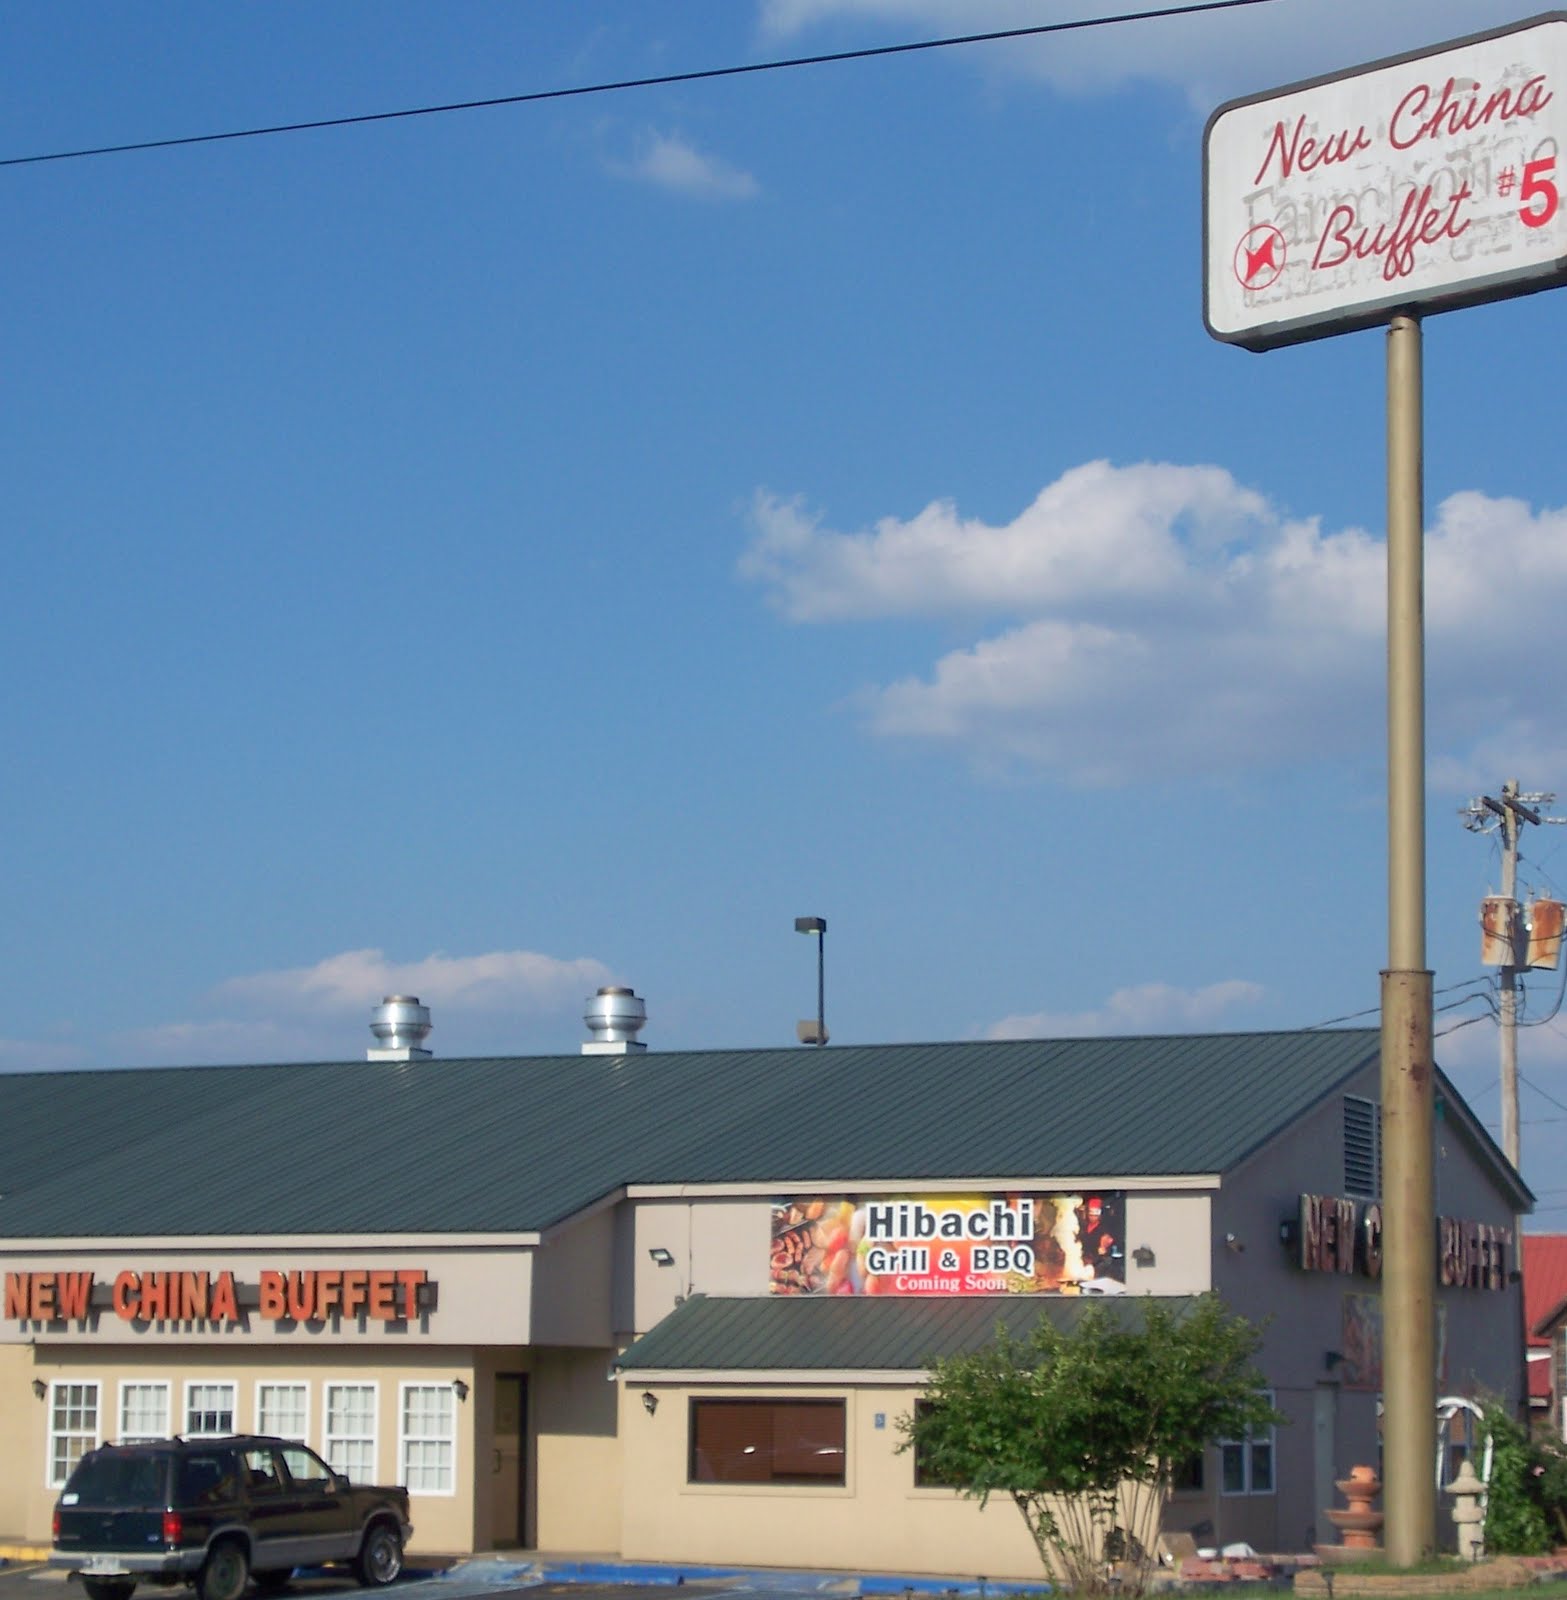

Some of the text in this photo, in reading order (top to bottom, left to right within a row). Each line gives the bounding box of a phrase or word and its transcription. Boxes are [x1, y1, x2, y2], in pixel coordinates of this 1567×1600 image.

[1254, 114, 1371, 186] New
[1388, 75, 1553, 150] China
[1311, 181, 1473, 281] Buffet
[867, 1202, 1031, 1239] Hibachi
[1301, 1193, 1356, 1274] NEW
[868, 1248, 1032, 1274] Grill & BBQ
[895, 1274, 1007, 1292] Coming Soon
[4, 1270, 428, 1321] NEW CHINA BUFFET
